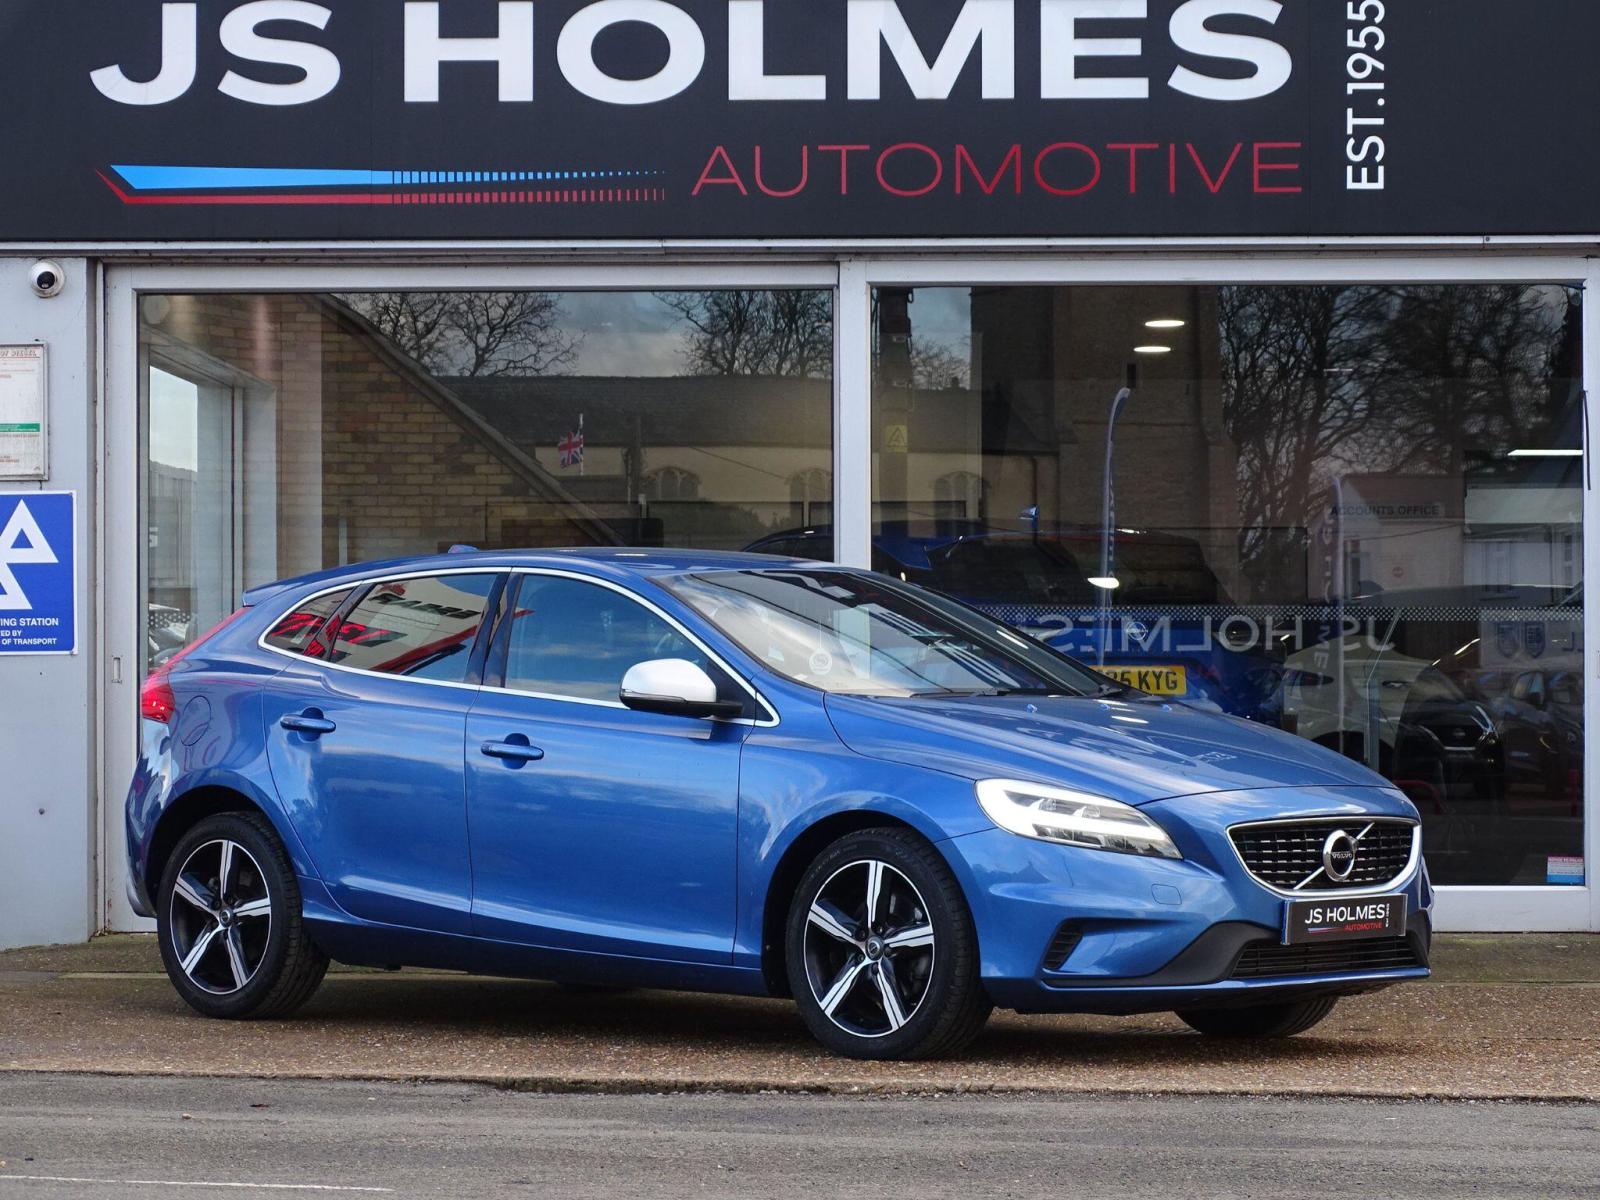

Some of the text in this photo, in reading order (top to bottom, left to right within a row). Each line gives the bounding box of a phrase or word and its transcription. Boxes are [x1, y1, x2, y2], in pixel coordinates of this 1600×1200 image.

[90, 0, 1293, 106] JS HOLMES
[1345, 0, 1386, 190] EST.1955
[691, 141, 1303, 198] AUTOMOTIVE
[1398, 505, 1439, 516] OFFICE
[0, 617, 59, 626] ING STATION
[1137, 669, 1178, 690] KYG
[1305, 908, 1323, 924] JS
[1327, 903, 1385, 921] HOLMES
[1345, 922, 1382, 931] AUTOMOTIVE
